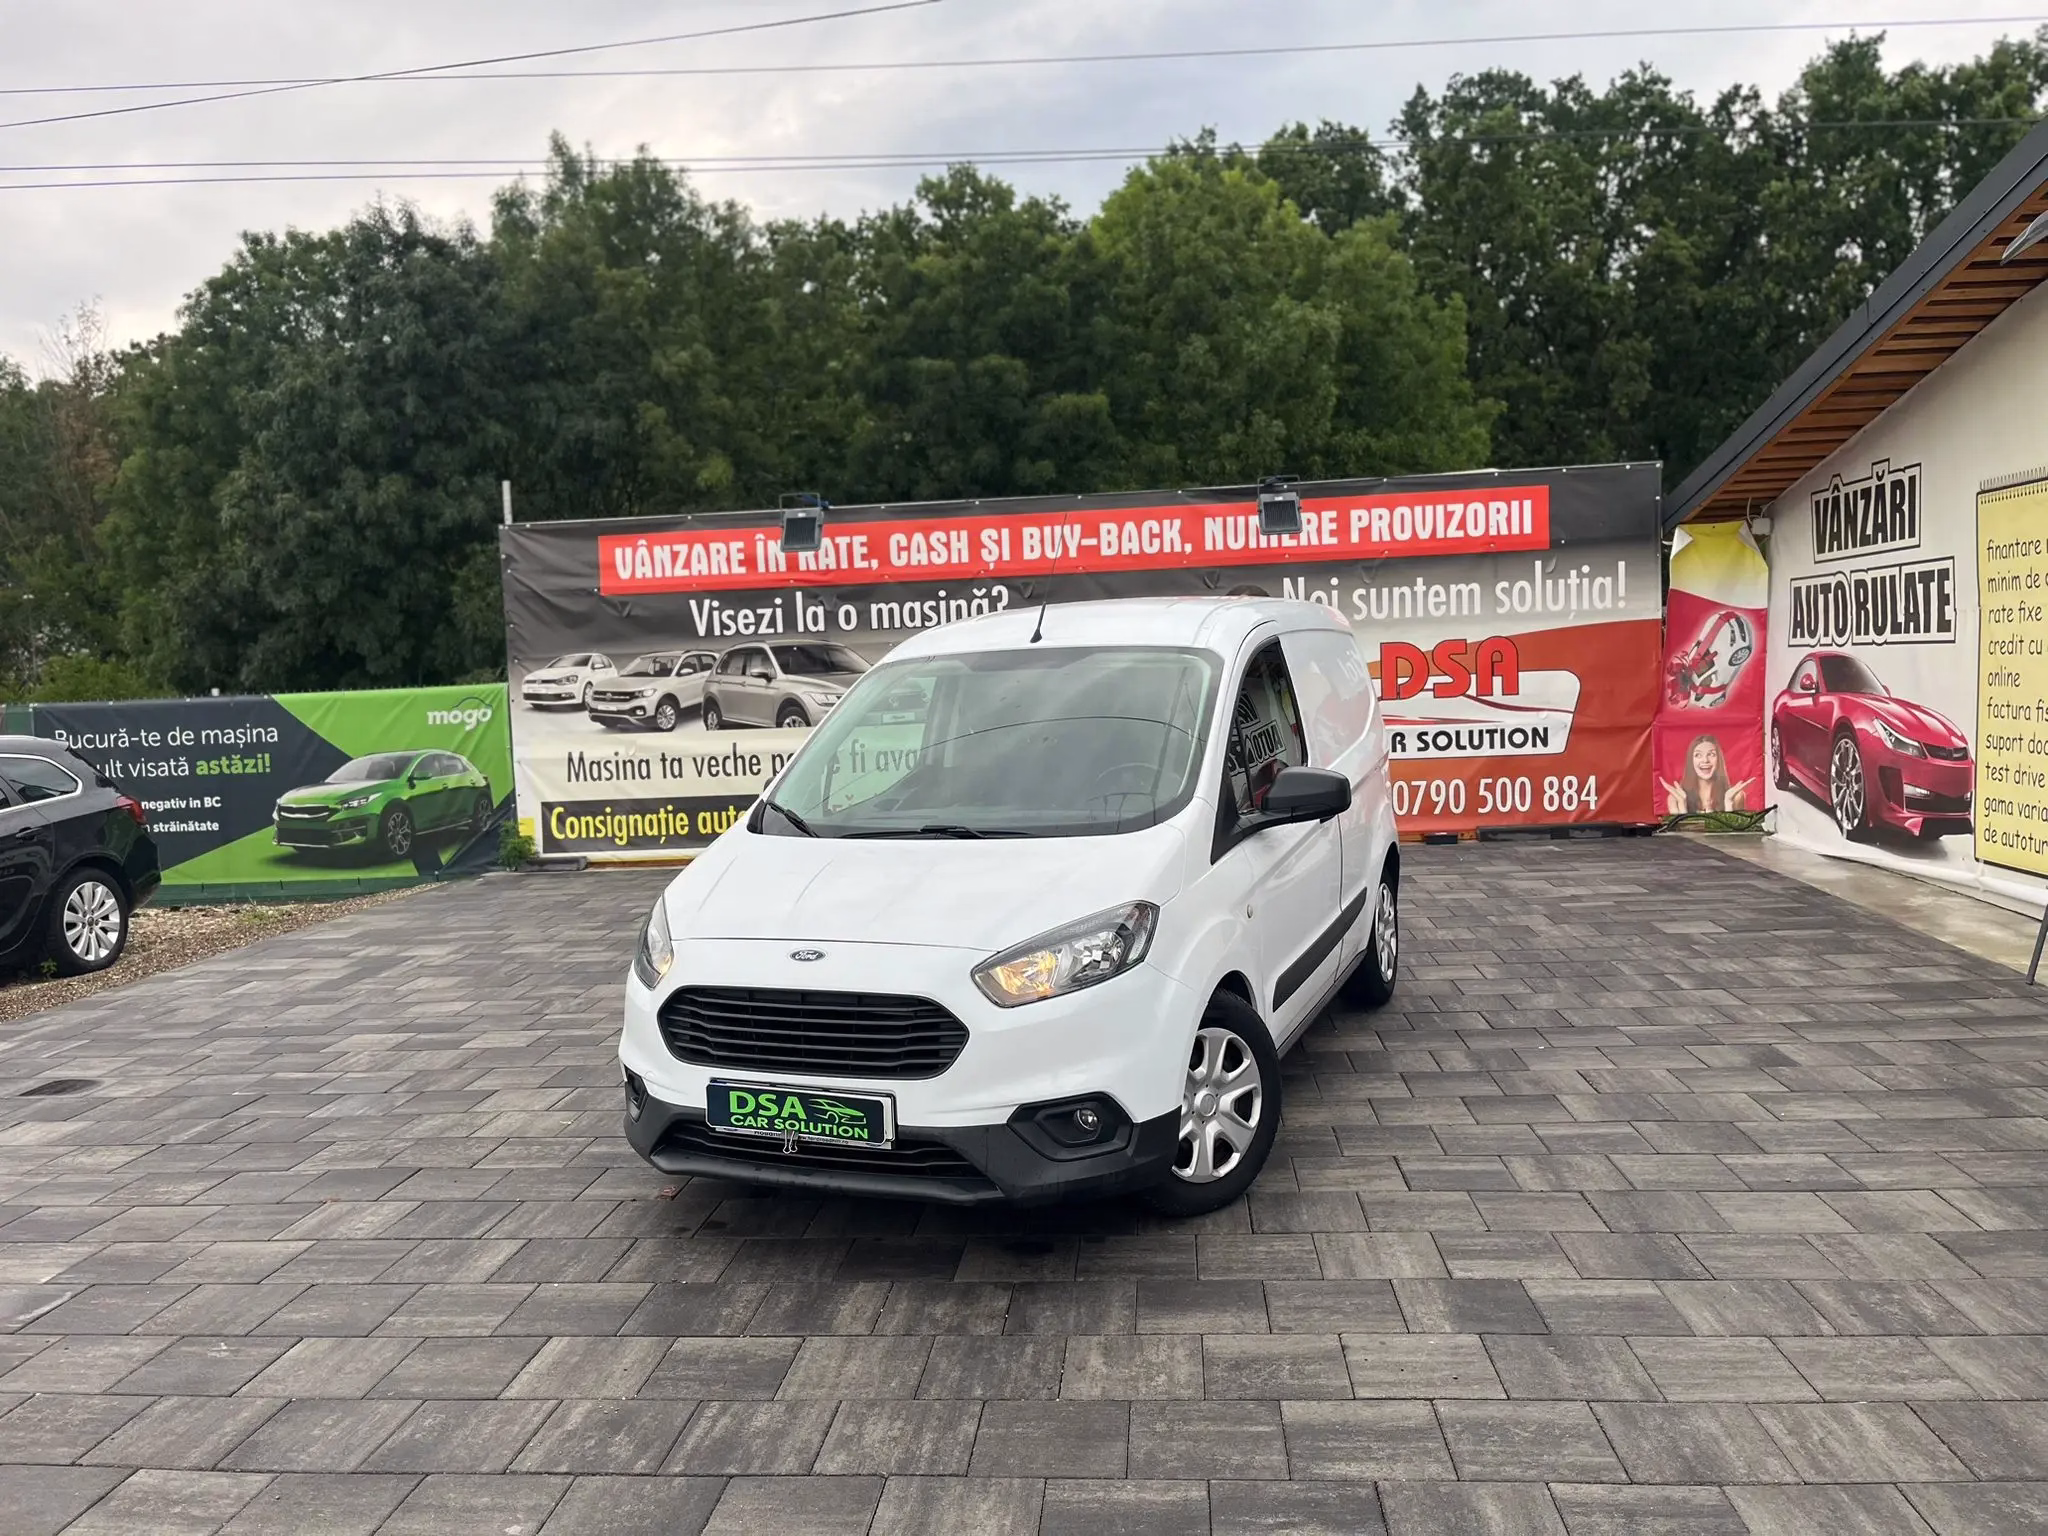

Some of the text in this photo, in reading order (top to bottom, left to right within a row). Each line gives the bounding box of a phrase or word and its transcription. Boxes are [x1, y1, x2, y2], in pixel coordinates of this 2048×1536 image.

[1814, 469, 1917, 555] VÂNZĂRI
[614, 538, 747, 581] VÂNZARE
[754, 533, 787, 574] ÎN
[798, 535, 879, 572] RATE,
[889, 529, 969, 567] CASH
[980, 528, 1010, 570] ȘI
[1022, 517, 1193, 561] BUY-BACK,
[1350, 499, 1532, 544] PROVIZORII
[1987, 538, 2042, 562] finantare
[1352, 577, 1481, 621] suntem
[1495, 560, 1626, 620] soluția!
[1987, 570, 2022, 593] minim
[2025, 566, 2041, 590] de
[689, 597, 784, 637] Visezi
[795, 590, 826, 633] la
[838, 603, 858, 631] o
[1792, 567, 1952, 640] AUTO RULATE
[1988, 600, 2043, 624] rate fixe
[1988, 633, 2043, 656] credit cu
[1379, 635, 1519, 701] DSA
[1987, 665, 2021, 688] online
[427, 708, 493, 732] mogo
[1986, 696, 2032, 721] factura
[168, 726, 195, 746] de
[201, 723, 279, 749] mașina
[1417, 726, 1549, 752] SOLUTION
[1985, 732, 2024, 757] suport
[97, 752, 272, 778] ult visată astăzi!
[567, 751, 651, 782] Masina
[660, 752, 683, 779] ta
[692, 742, 762, 778] veche
[1984, 761, 2046, 789] test drive
[141, 796, 222, 812] negativ in BC
[1391, 775, 1598, 816] 0790 500 884
[1983, 796, 2014, 818] gama
[153, 820, 219, 832] străinătate
[551, 804, 689, 845] Consignație
[1983, 822, 1998, 844] de
[728, 1090, 808, 1120] DSA
[730, 1114, 869, 1140] CAR SOLUTION
